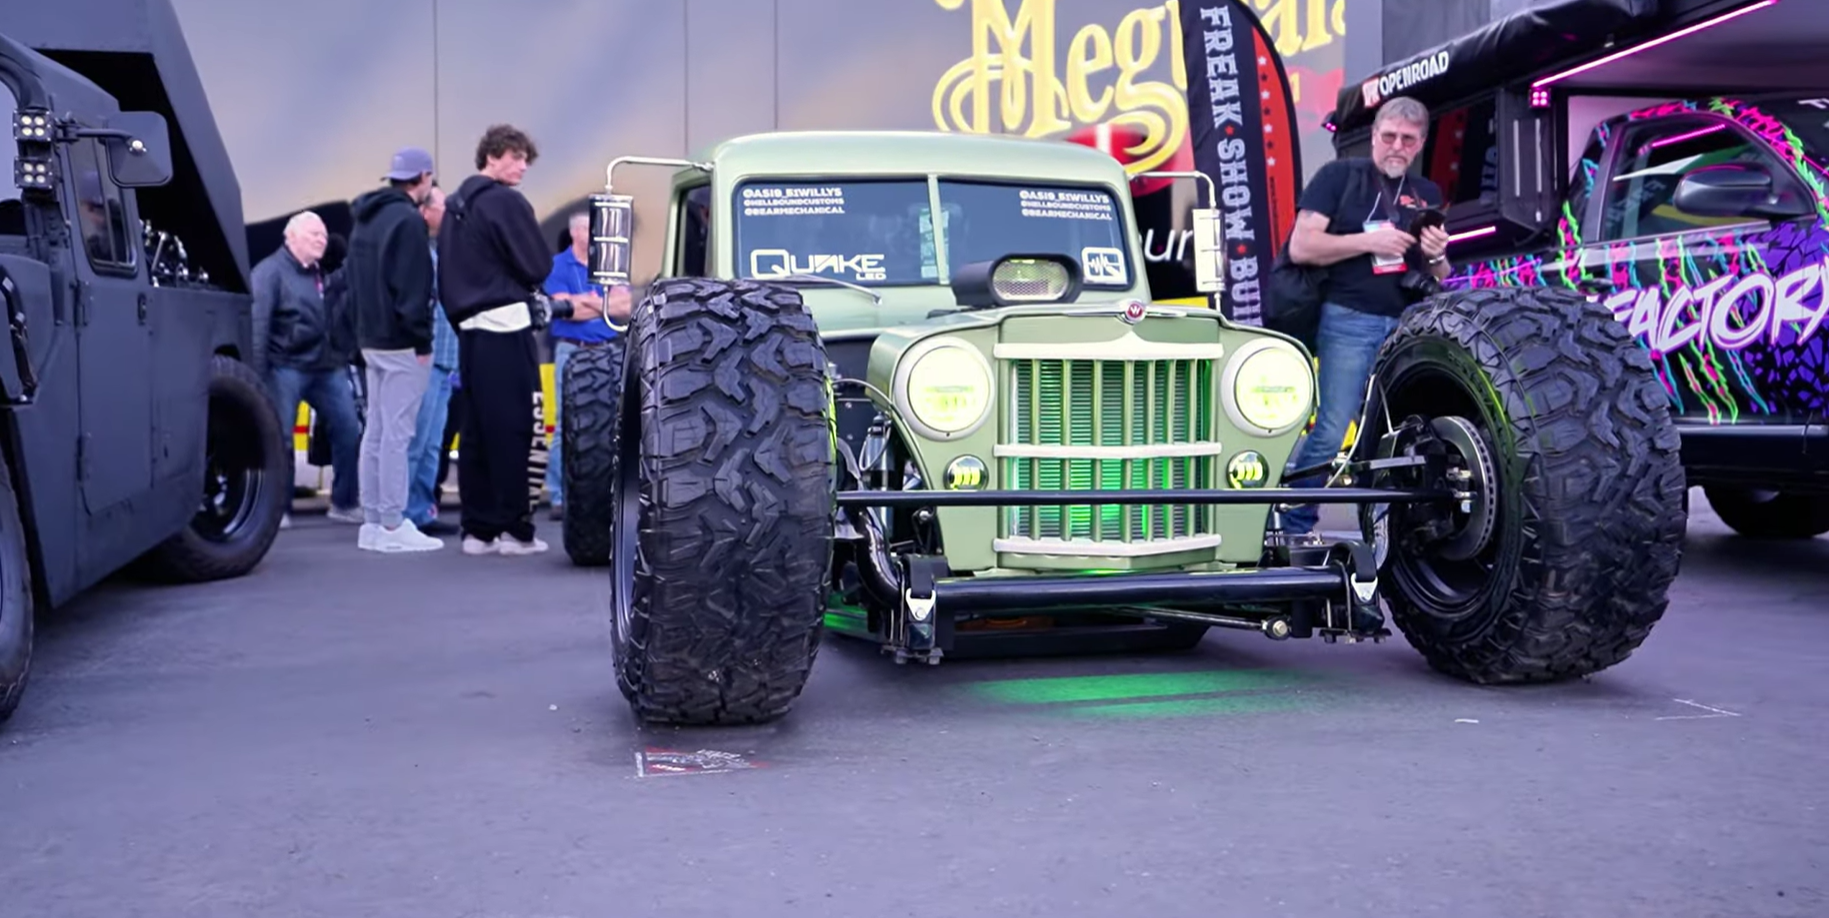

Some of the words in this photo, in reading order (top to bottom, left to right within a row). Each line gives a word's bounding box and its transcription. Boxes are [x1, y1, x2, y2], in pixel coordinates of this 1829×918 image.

[1200, 5, 1243, 129] FREAK
[1379, 50, 1449, 96] OPENROAD
[1217, 138, 1255, 240] SHOW
[855, 272, 887, 281] LED
